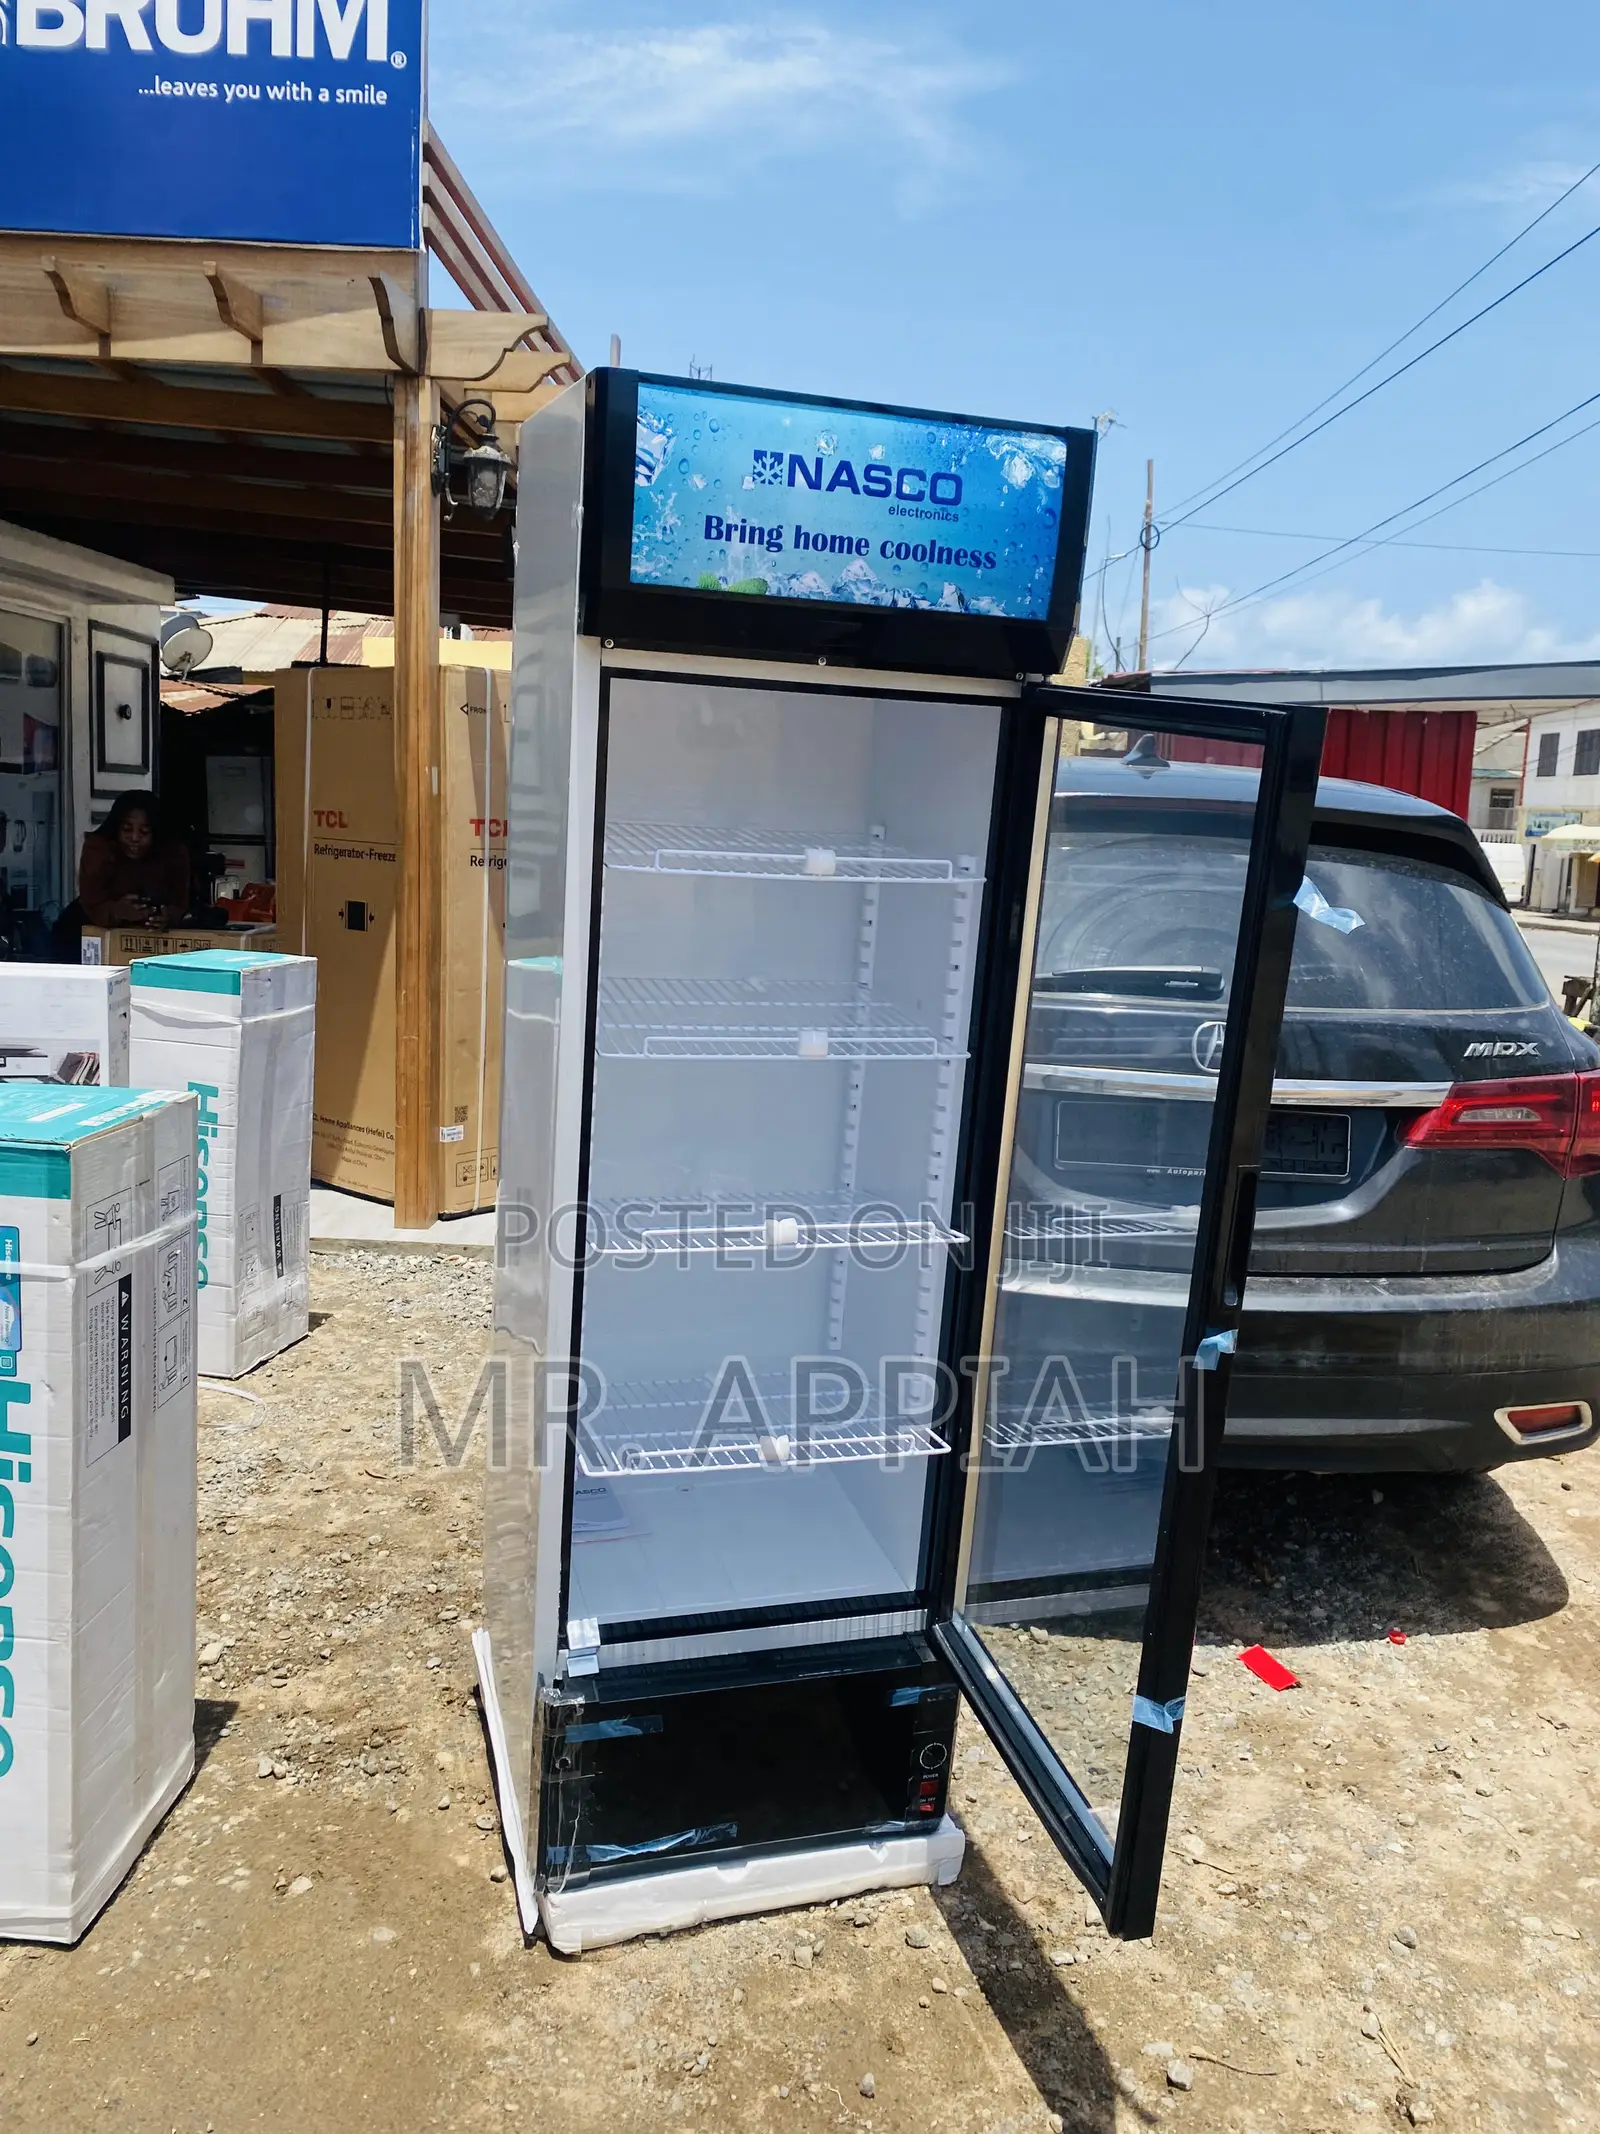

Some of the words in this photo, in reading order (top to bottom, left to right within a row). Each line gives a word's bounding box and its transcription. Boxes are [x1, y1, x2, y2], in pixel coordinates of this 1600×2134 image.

[224, 81, 261, 103] you
[268, 81, 313, 102] with
[318, 88, 330, 103] a
[336, 84, 388, 105] smile
[787, 453, 963, 506] NASCO
[888, 505, 960, 522] electronics
[704, 514, 783, 552] Bring
[793, 525, 870, 556] home
[880, 539, 997, 569] coolness
[313, 810, 348, 829] TCL
[470, 854, 508, 870] Rerig
[1463, 1042, 1542, 1057] MDX
[4, 1238, 13, 1281] Hisee
[121, 1314, 129, 1419] WARNING
[574, 1487, 606, 1495] ASCO
